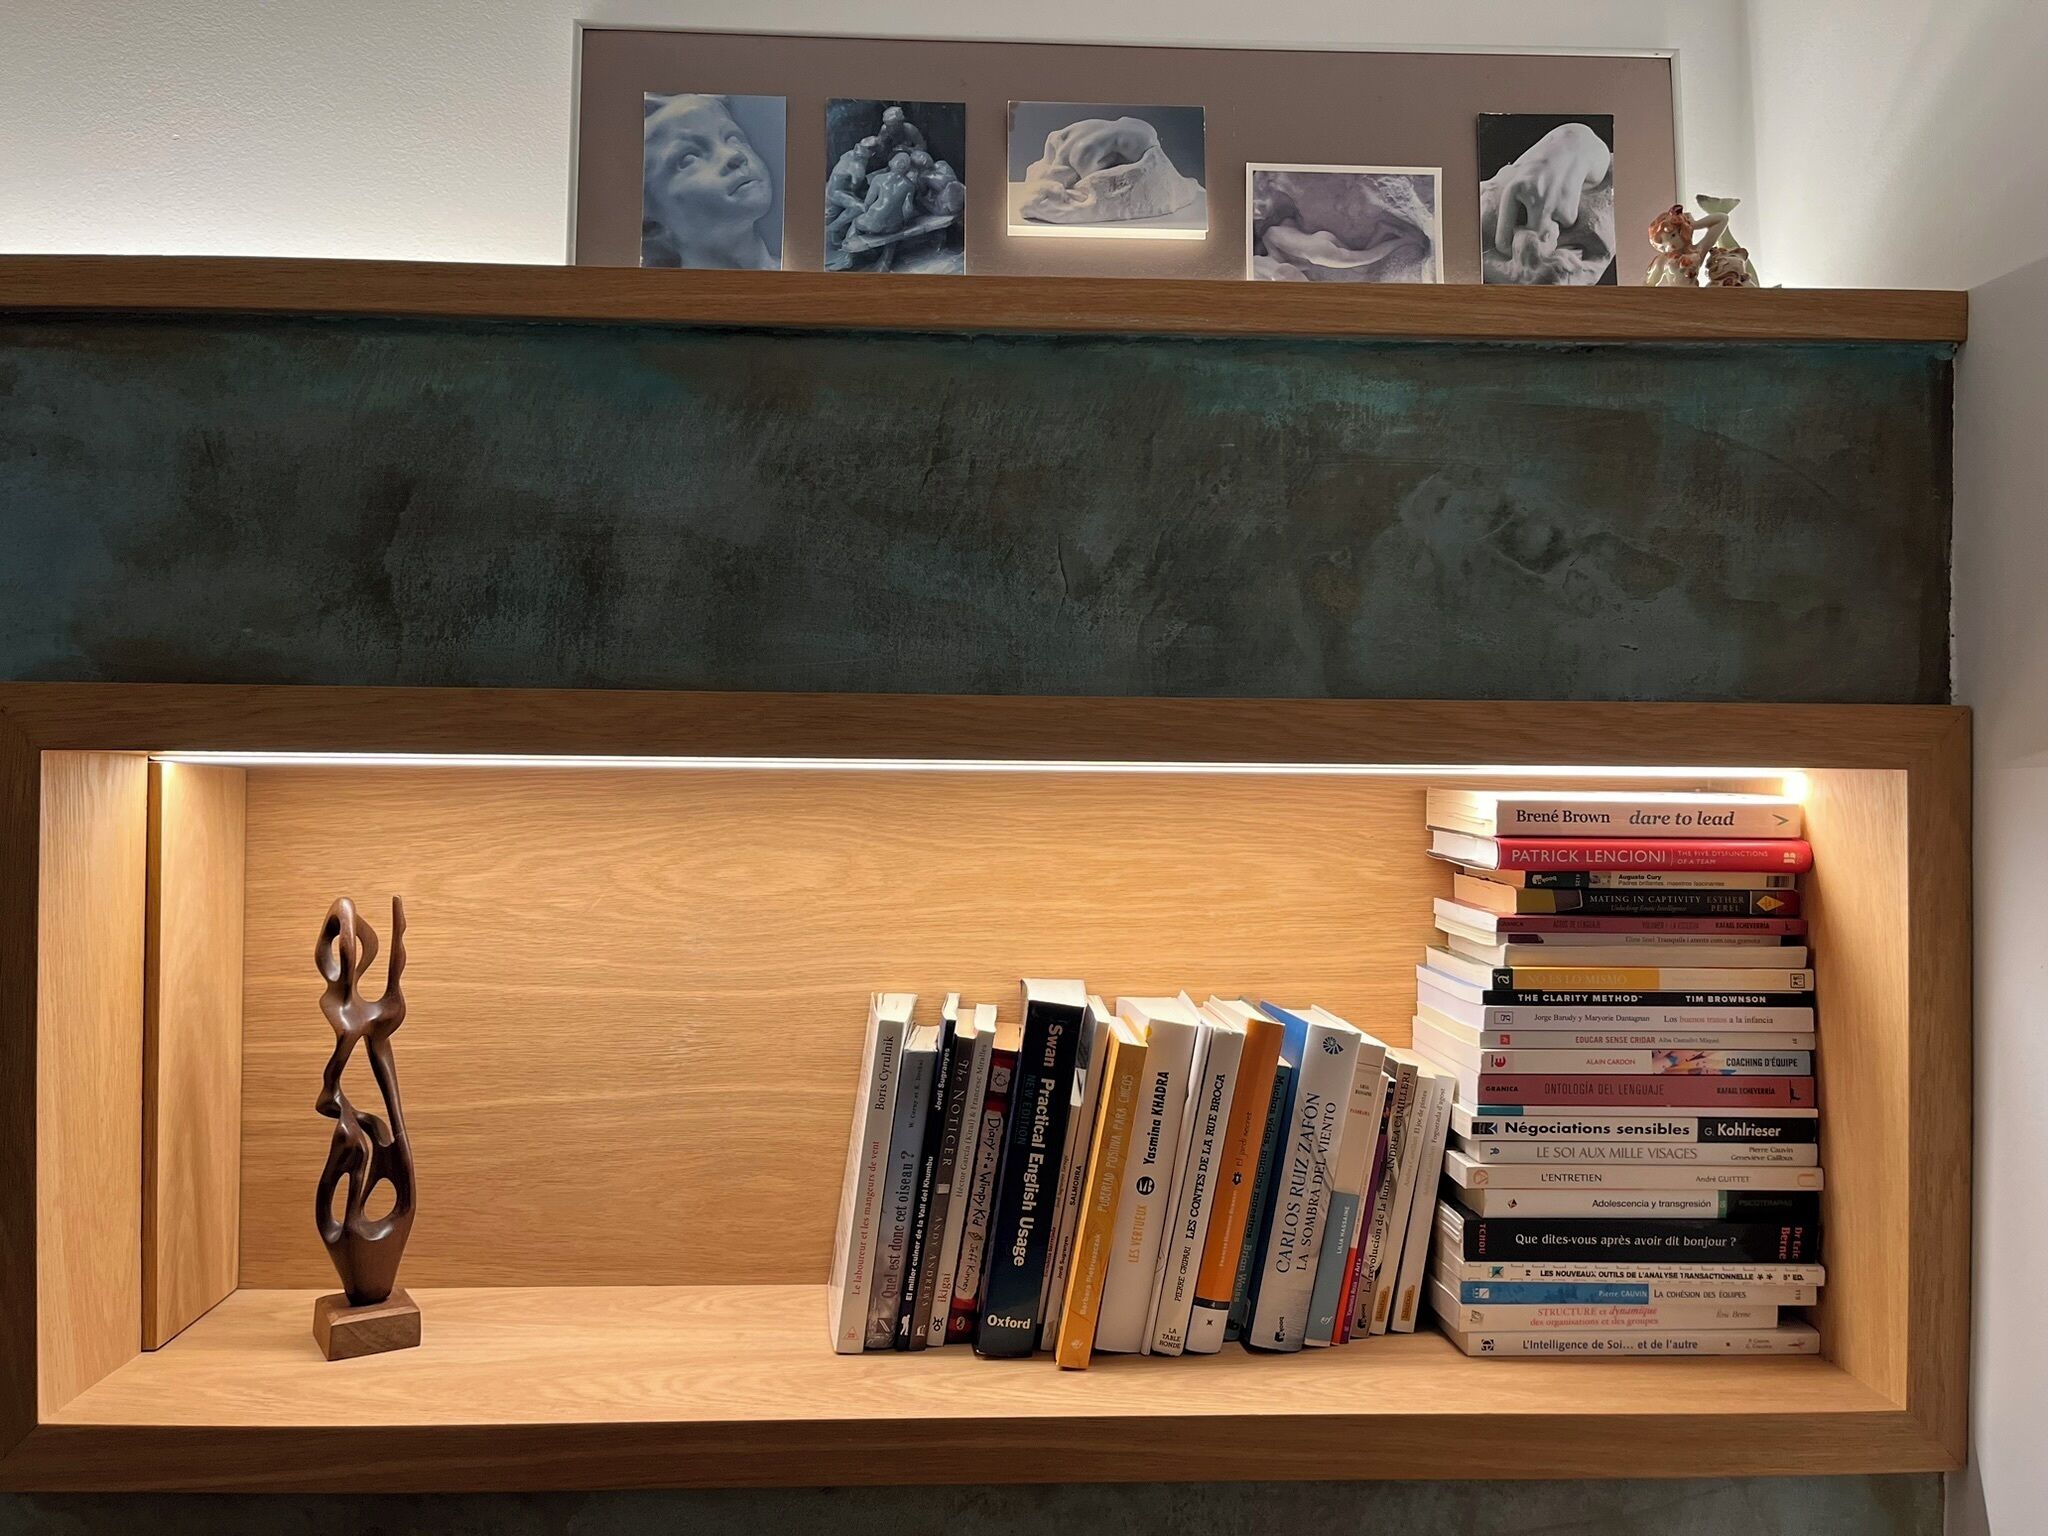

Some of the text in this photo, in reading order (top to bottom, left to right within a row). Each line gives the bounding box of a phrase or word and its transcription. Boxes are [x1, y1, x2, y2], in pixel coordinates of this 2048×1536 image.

[1516, 809, 1735, 826] Brené Brown dare to lead
[1511, 849, 1666, 863] PATRICK LENCIONI
[1646, 874, 1662, 882] Cury
[1589, 895, 1702, 904] MATING IN CAPTIVITY
[1706, 896, 1745, 904] ESTHER
[1711, 904, 1740, 912] PEREL
[1518, 994, 1539, 1002] THE
[1542, 994, 1588, 1002] CLARITY
[1685, 995, 1704, 1003] TIM
[1707, 995, 1766, 1003] BROWNSON
[1575, 1036, 1656, 1044] EDUCAR SENSE CRIDAR
[1726, 1057, 1763, 1067] COACHING
[1764, 1056, 1798, 1068] D'ÉQUIPE
[875, 1035, 894, 1110] Boris Cyrulnik
[1271, 1074, 1285, 1115] Muchas
[1544, 1080, 1593, 1096] ONTOLOGÍA
[1598, 1083, 1615, 1096] DEL
[1618, 1083, 1664, 1096] LENGUAJE
[1393, 1071, 1411, 1129] CAMILLERI
[942, 1060, 970, 1166] The NOTICER
[983, 1117, 1001, 1151] Diary
[1505, 1121, 1782, 1137] Négociations sensibles G. Kohlrieser
[1012, 1023, 1063, 1267] Swan Practical English Usage
[1385, 1128, 1401, 1174] ANDREA
[1537, 1147, 1698, 1160] LE SOI AUX MILLE VISAGES
[985, 1151, 994, 1163] of
[905, 1047, 951, 1301] El millor cuiner de la Vall del Khumbu Jordi Sugranyes
[1127, 1071, 1171, 1264] LES VERTUEUX Yasmina KHADRA
[1256, 1150, 1268, 1190] muchos
[1070, 1164, 1082, 1206] SALMORRA
[1275, 1092, 1321, 1275] CARLOS RUIZ ZAFÓN
[1296, 1101, 1337, 1271] LA SOMBRA DEL VIENTO
[1541, 1173, 1603, 1182] L'ENTRETIEN
[972, 1170, 992, 1210] Wimpy
[1174, 1074, 1226, 1302] PIERRE GRIPARI LES CONTES DE LA RUE BROCA
[1380, 1178, 1391, 1201] luna
[1379, 1201, 1387, 1213] la
[1592, 1199, 1712, 1210] Adolescencia y transgresión
[852, 1141, 880, 1295] Le laboureur et les mangeurs de vent
[972, 1208, 986, 1227] Kid
[1246, 1191, 1260, 1239] maestros
[1376, 1213, 1385, 1227] de
[881, 1151, 914, 1299] Quel est donc cet oiseau ?
[1478, 1223, 1487, 1255] TCHOU
[1515, 1233, 1737, 1249] Que dites-vous après avoir dit bonjour ?
[1778, 1227, 1791, 1260] Berne
[922, 1216, 944, 1306] ANDY ANDREWS
[967, 1243, 979, 1262] Jeff
[1240, 1243, 1253, 1271] Brian
[1368, 1231, 1384, 1280] revolución
[960, 1263, 976, 1293] Kinney
[1555, 1270, 1597, 1278] NOUVEAUX
[1598, 1270, 1624, 1279] OUTILS
[1626, 1271, 1636, 1279] DE
[1638, 1271, 1679, 1280] L'ANALYSE
[1680, 1272, 1755, 1281] TRANSACTIONNELLE
[1362, 1279, 1372, 1294] La
[1620, 1290, 1648, 1298] CAUVIN
[1537, 1307, 1597, 1316] STRUCTURE
[1608, 1306, 1657, 1318] dynamique
[987, 1313, 1032, 1330] Oxford
[1530, 1318, 1544, 1326] des
[1546, 1318, 1599, 1328] organisations
[1611, 1318, 1626, 1327] des
[1626, 1320, 1659, 1328] groupes
[1162, 1333, 1182, 1343] TABLE
[1168, 1327, 1177, 1335] LA
[1158, 1340, 1182, 1350] RONDE
[1522, 1339, 1588, 1351] L'Intelligence
[1591, 1340, 1604, 1350] de
[1637, 1341, 1648, 1350] et
[1650, 1339, 1663, 1350] de
[1666, 1339, 1698, 1350] l'autre
